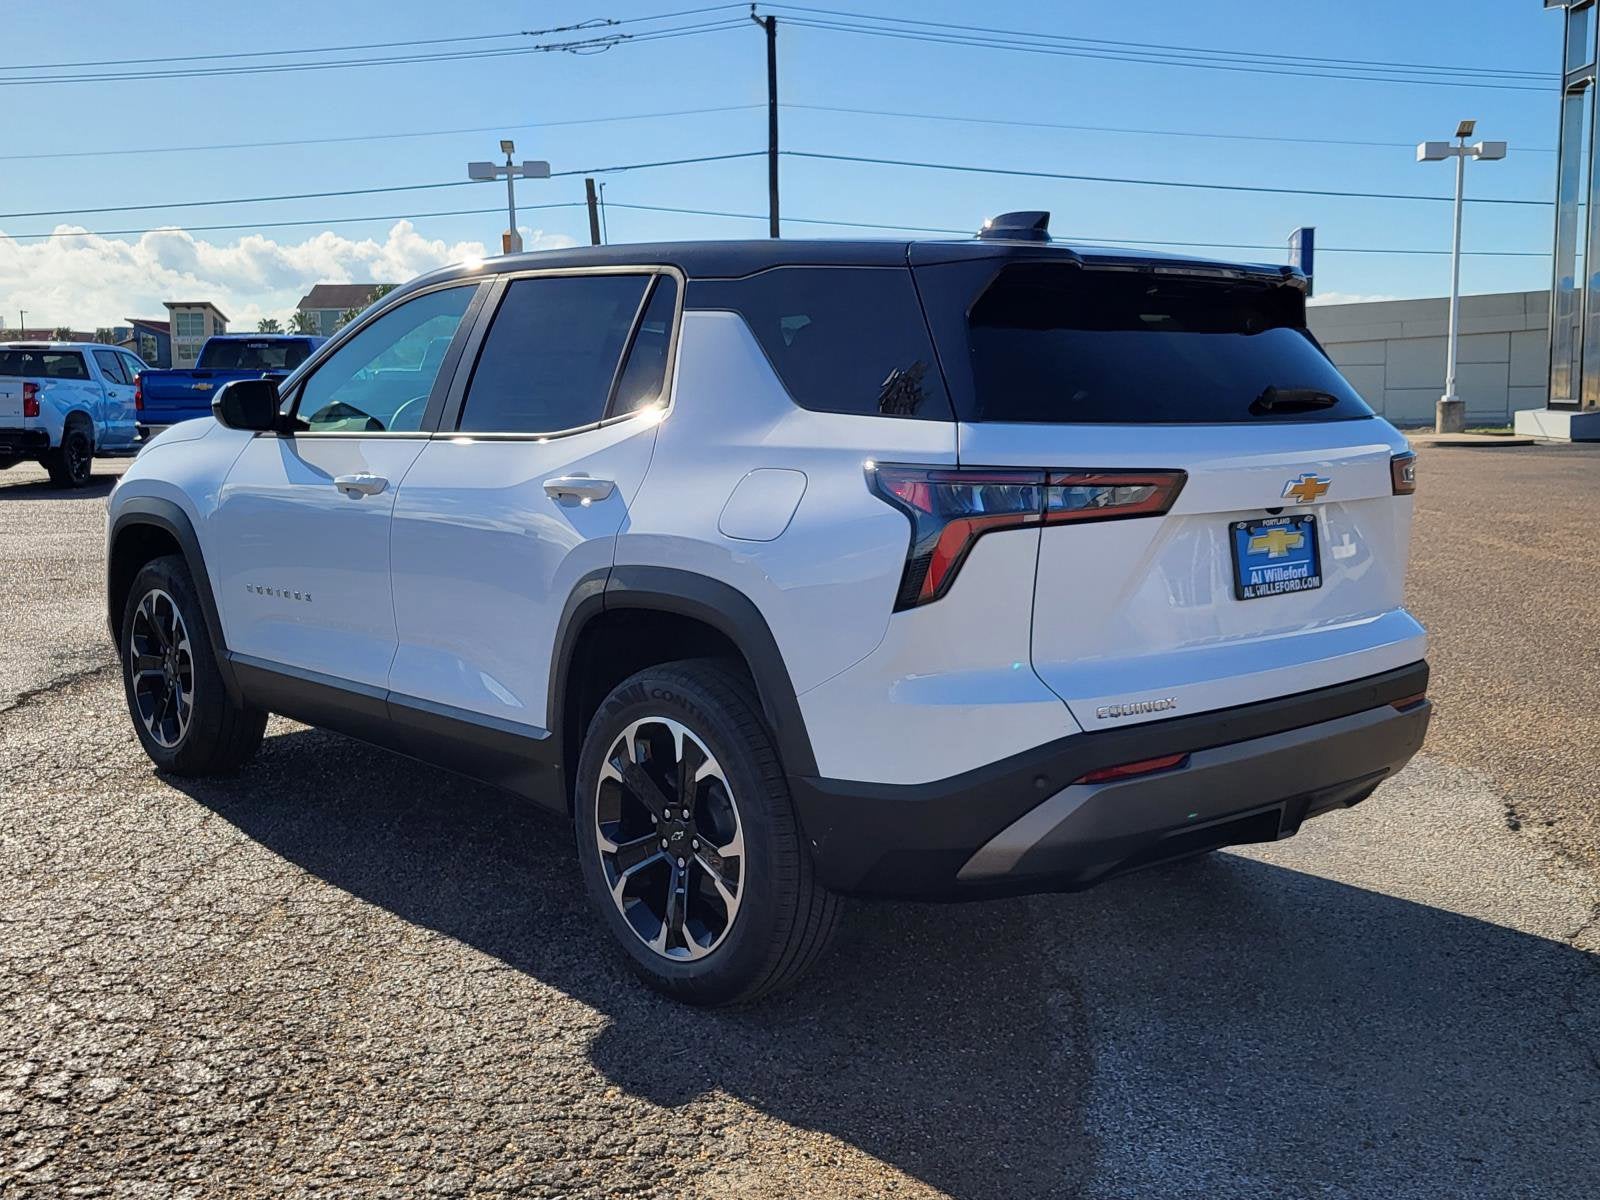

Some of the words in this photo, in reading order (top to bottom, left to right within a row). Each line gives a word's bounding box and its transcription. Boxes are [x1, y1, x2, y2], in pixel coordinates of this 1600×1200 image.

[1262, 517, 1291, 527] PORTLAND
[1250, 570, 1263, 585] Al
[1264, 564, 1308, 583] Willeford
[1243, 586, 1255, 598] AL
[1255, 576, 1320, 596] WILLEFORD.COM
[1095, 696, 1177, 719] EQUINOX
